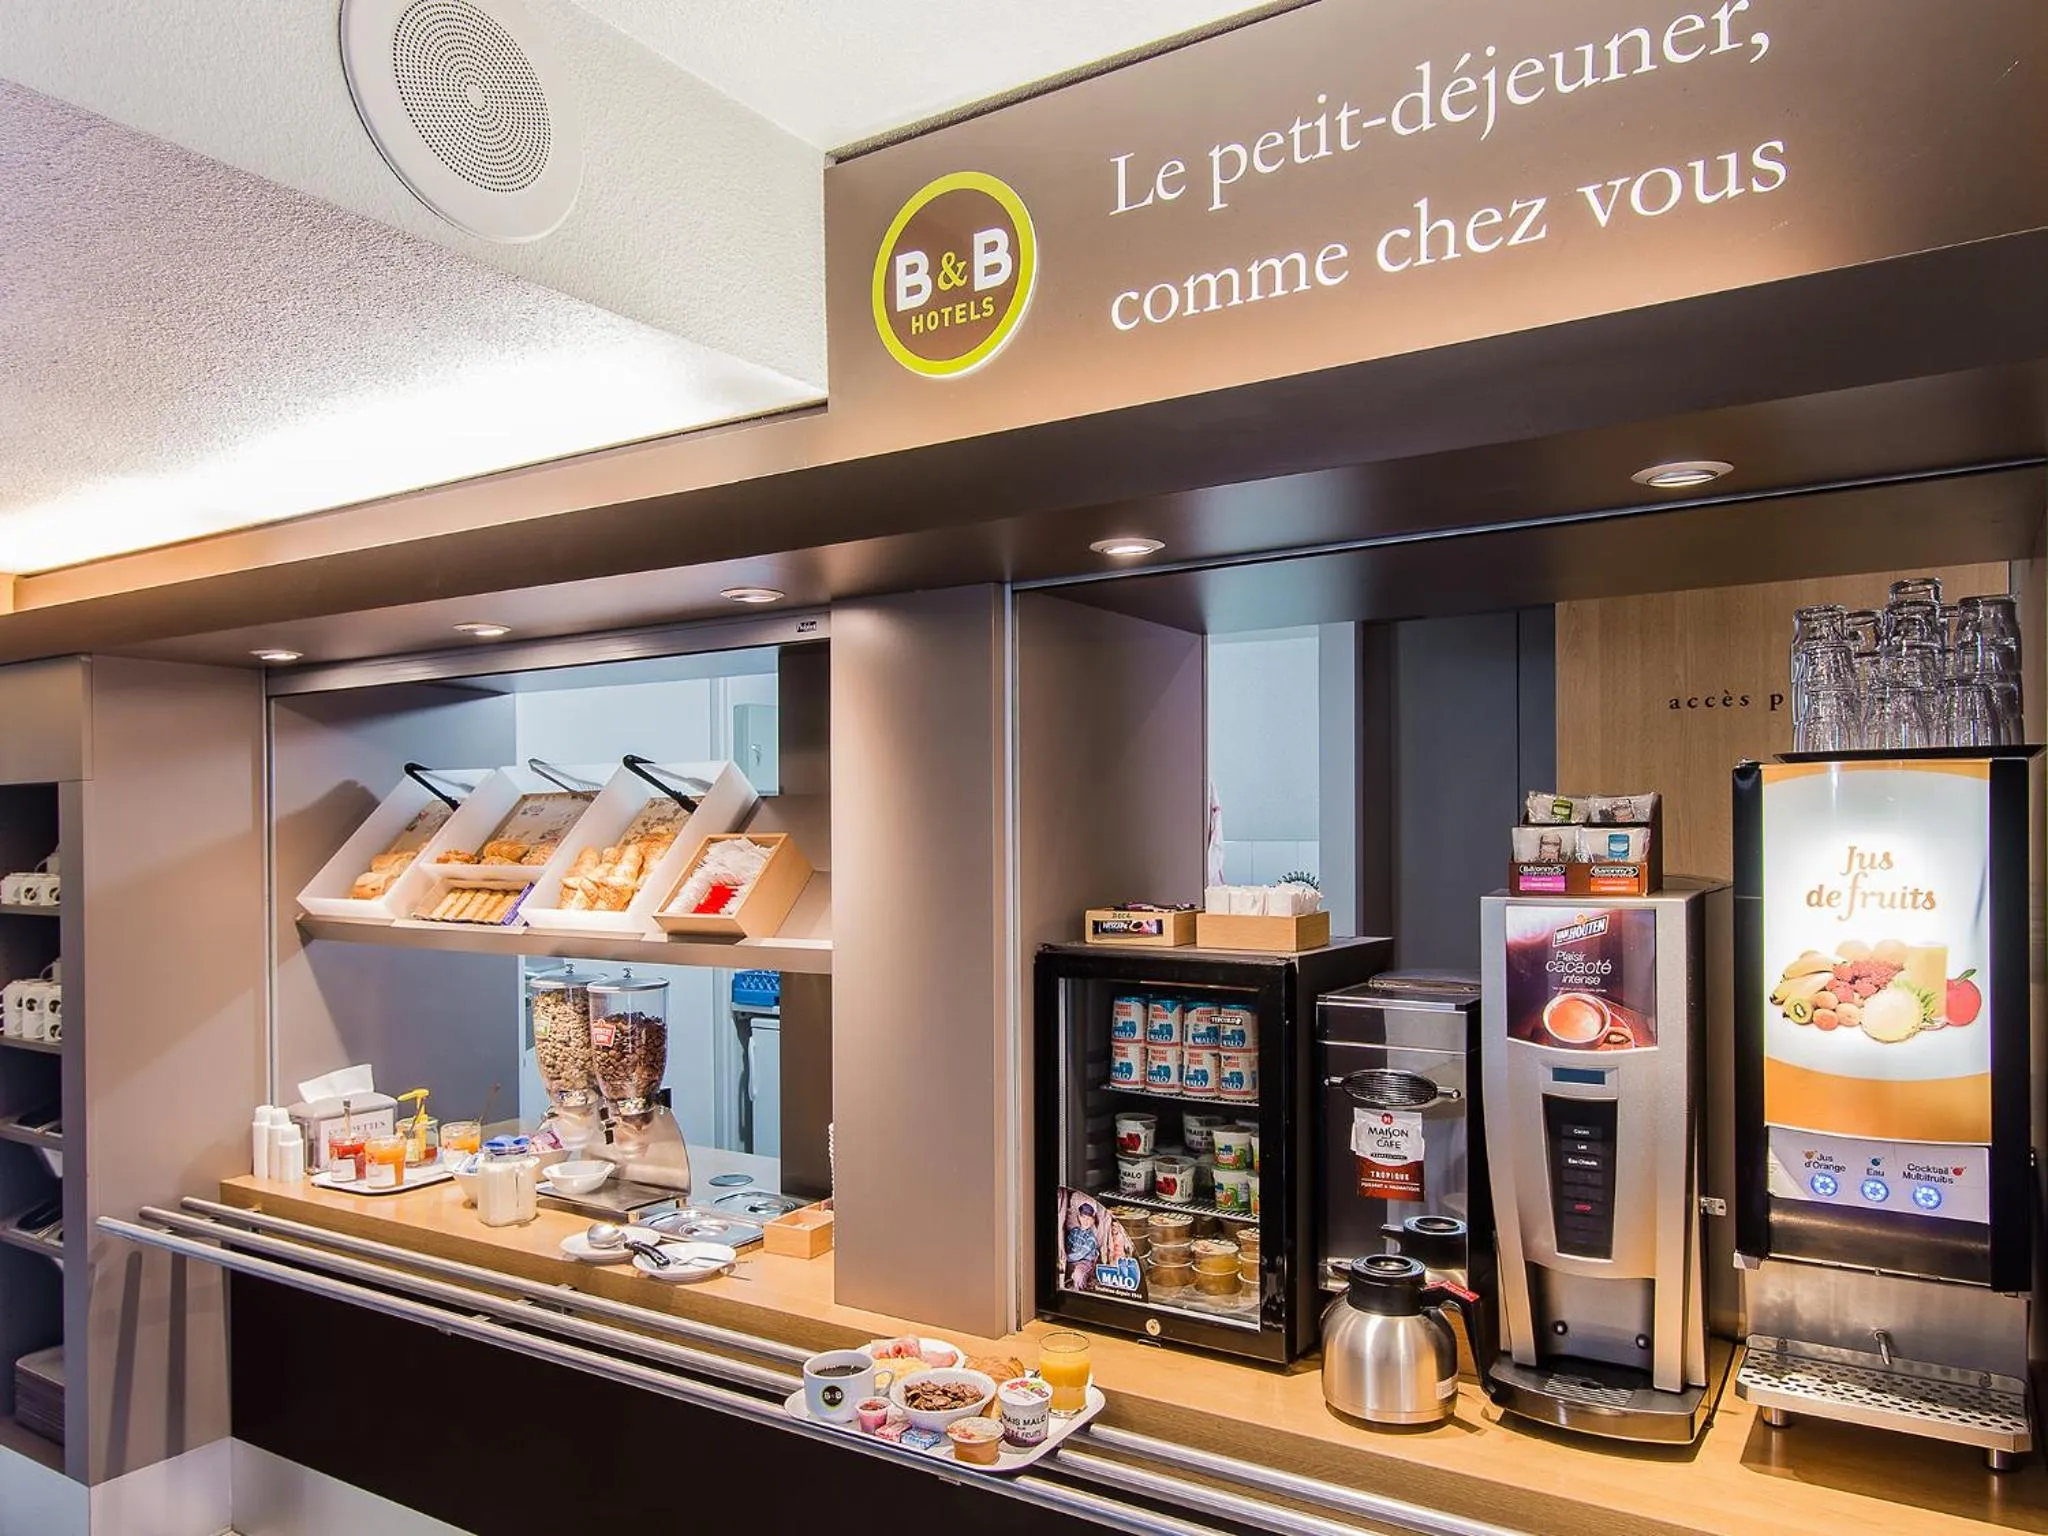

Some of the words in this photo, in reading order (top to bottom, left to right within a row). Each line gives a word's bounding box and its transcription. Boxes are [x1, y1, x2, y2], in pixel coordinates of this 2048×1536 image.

[1110, 150, 1187, 216] Le
[1207, 0, 1772, 212] petit-déjeuner,
[1111, 239, 1349, 331] comme
[1376, 195, 1547, 274] chez
[1577, 138, 1788, 229] vous
[910, 296, 996, 335] HOTELS
[1669, 689, 1750, 711] accès
[1840, 846, 1894, 876] Jus
[1806, 884, 1842, 908] de
[1838, 872, 1936, 922] fruits
[1556, 951, 1586, 961] Plaisir
[1545, 960, 1612, 975] cacaoté
[1562, 975, 1601, 985] intense
[1368, 1127, 1408, 1138] MAISON
[1818, 1154, 1833, 1163] Jus
[1866, 1168, 1885, 1177] Eau
[1907, 1164, 1949, 1176] Cocktail
[1101, 1272, 1135, 1288] MALO
